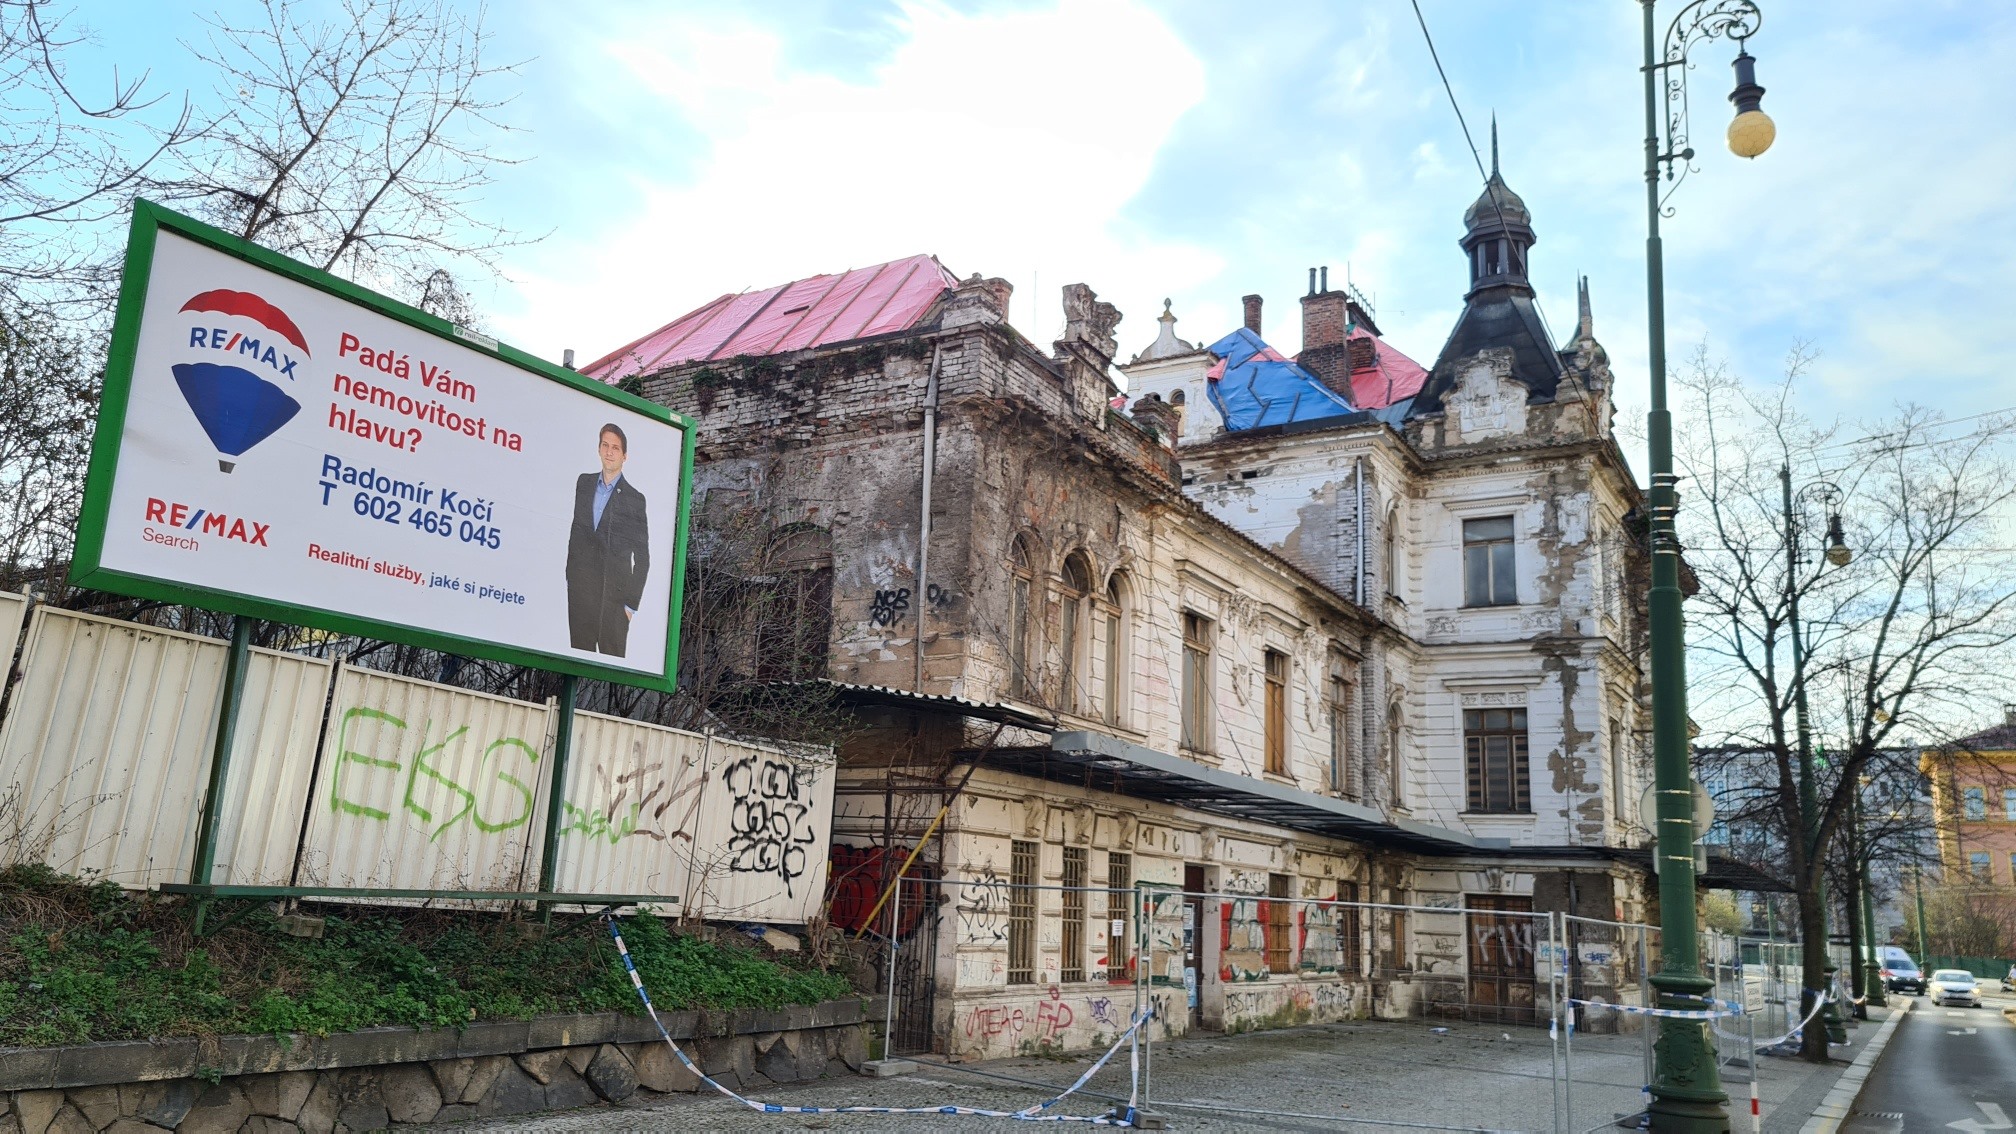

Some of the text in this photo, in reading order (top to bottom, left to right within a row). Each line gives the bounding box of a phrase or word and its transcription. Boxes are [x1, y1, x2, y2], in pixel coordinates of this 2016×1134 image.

[189, 327, 298, 381] RE/MAX
[338, 332, 477, 403] Padá Vám
[328, 403, 423, 453] hlavu?
[333, 371, 523, 452] nemovitost na
[318, 480, 501, 550] T 602 465 045
[321, 453, 496, 523] Radomír Kočí
[142, 527, 199, 552] Search
[145, 497, 271, 547] RE/MAX
[308, 543, 526, 605] Realitní služby, jaké si přejete
